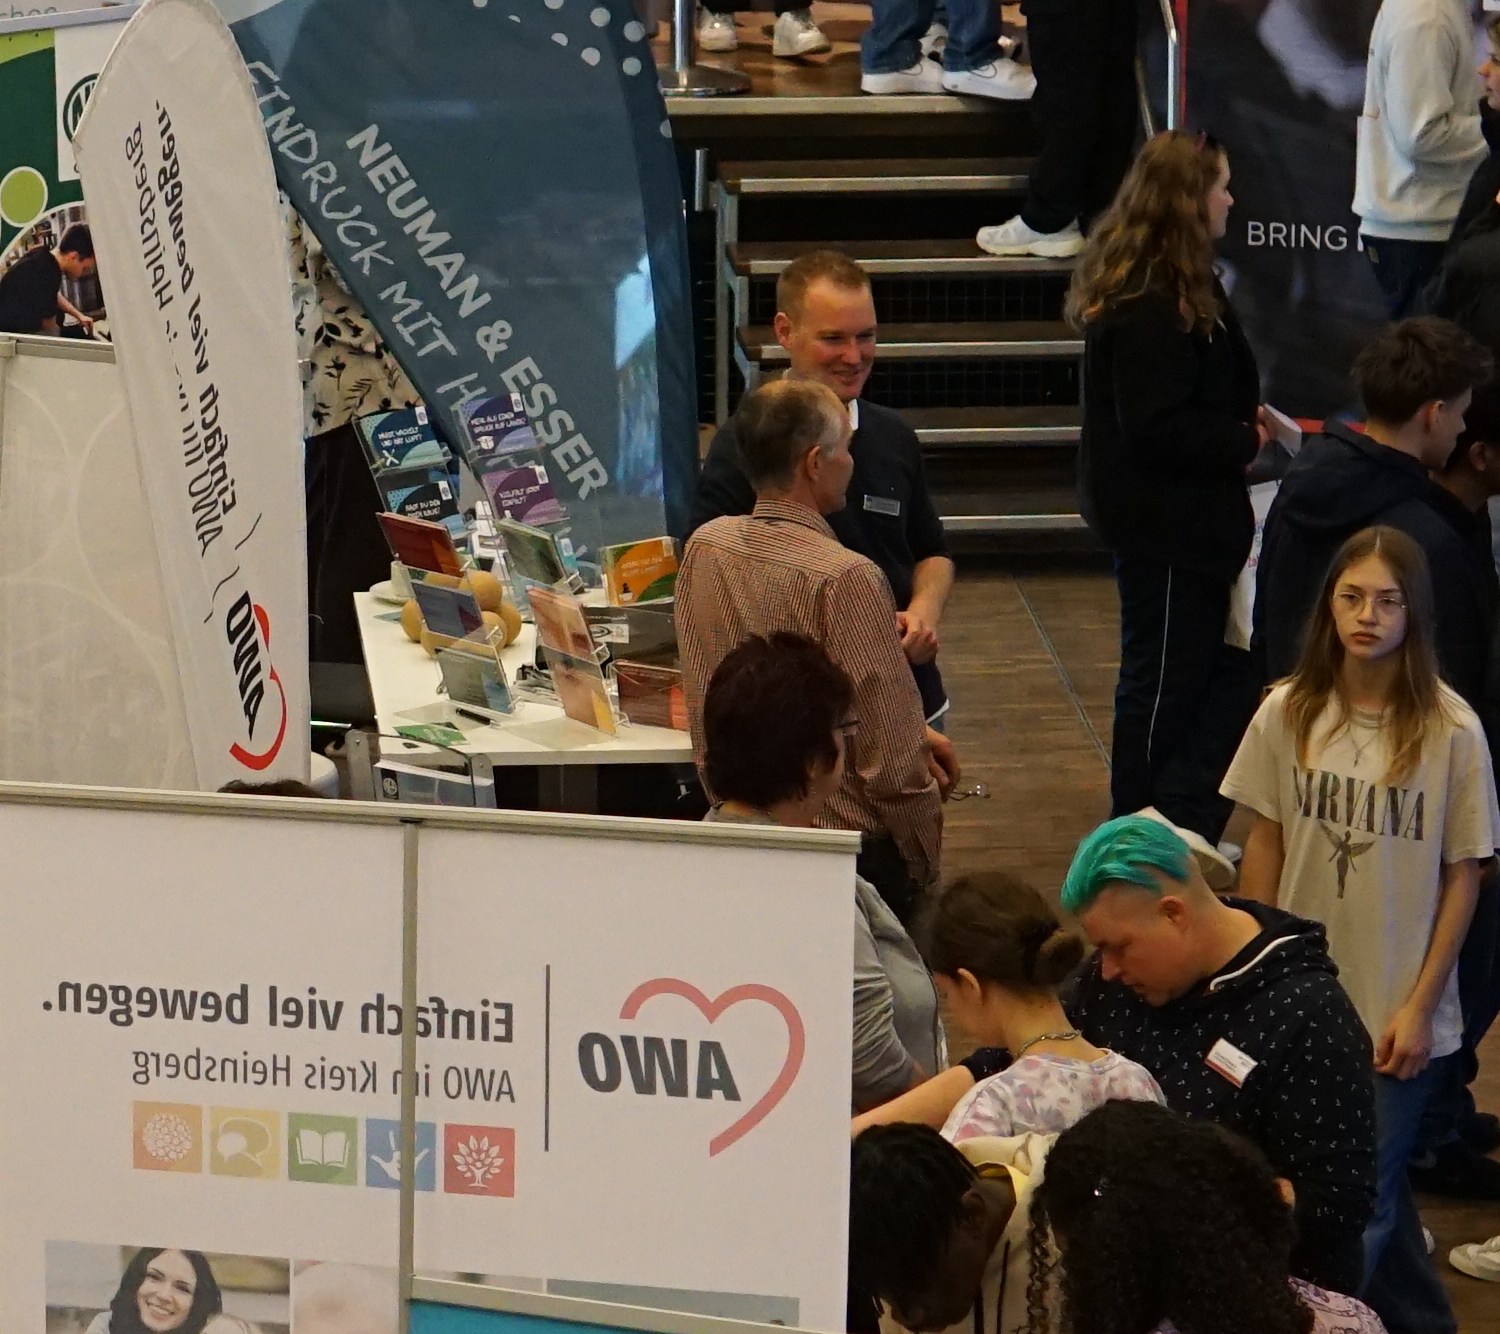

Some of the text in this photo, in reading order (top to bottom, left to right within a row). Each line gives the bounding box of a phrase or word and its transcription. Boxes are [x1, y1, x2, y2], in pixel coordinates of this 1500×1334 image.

[1248, 220, 1348, 251] BRING
[346, 123, 496, 320] NEUMAN
[475, 318, 517, 367] &
[500, 355, 609, 502] ESSER
[379, 279, 458, 360] MIT
[1293, 766, 1424, 841] NIRVANA
